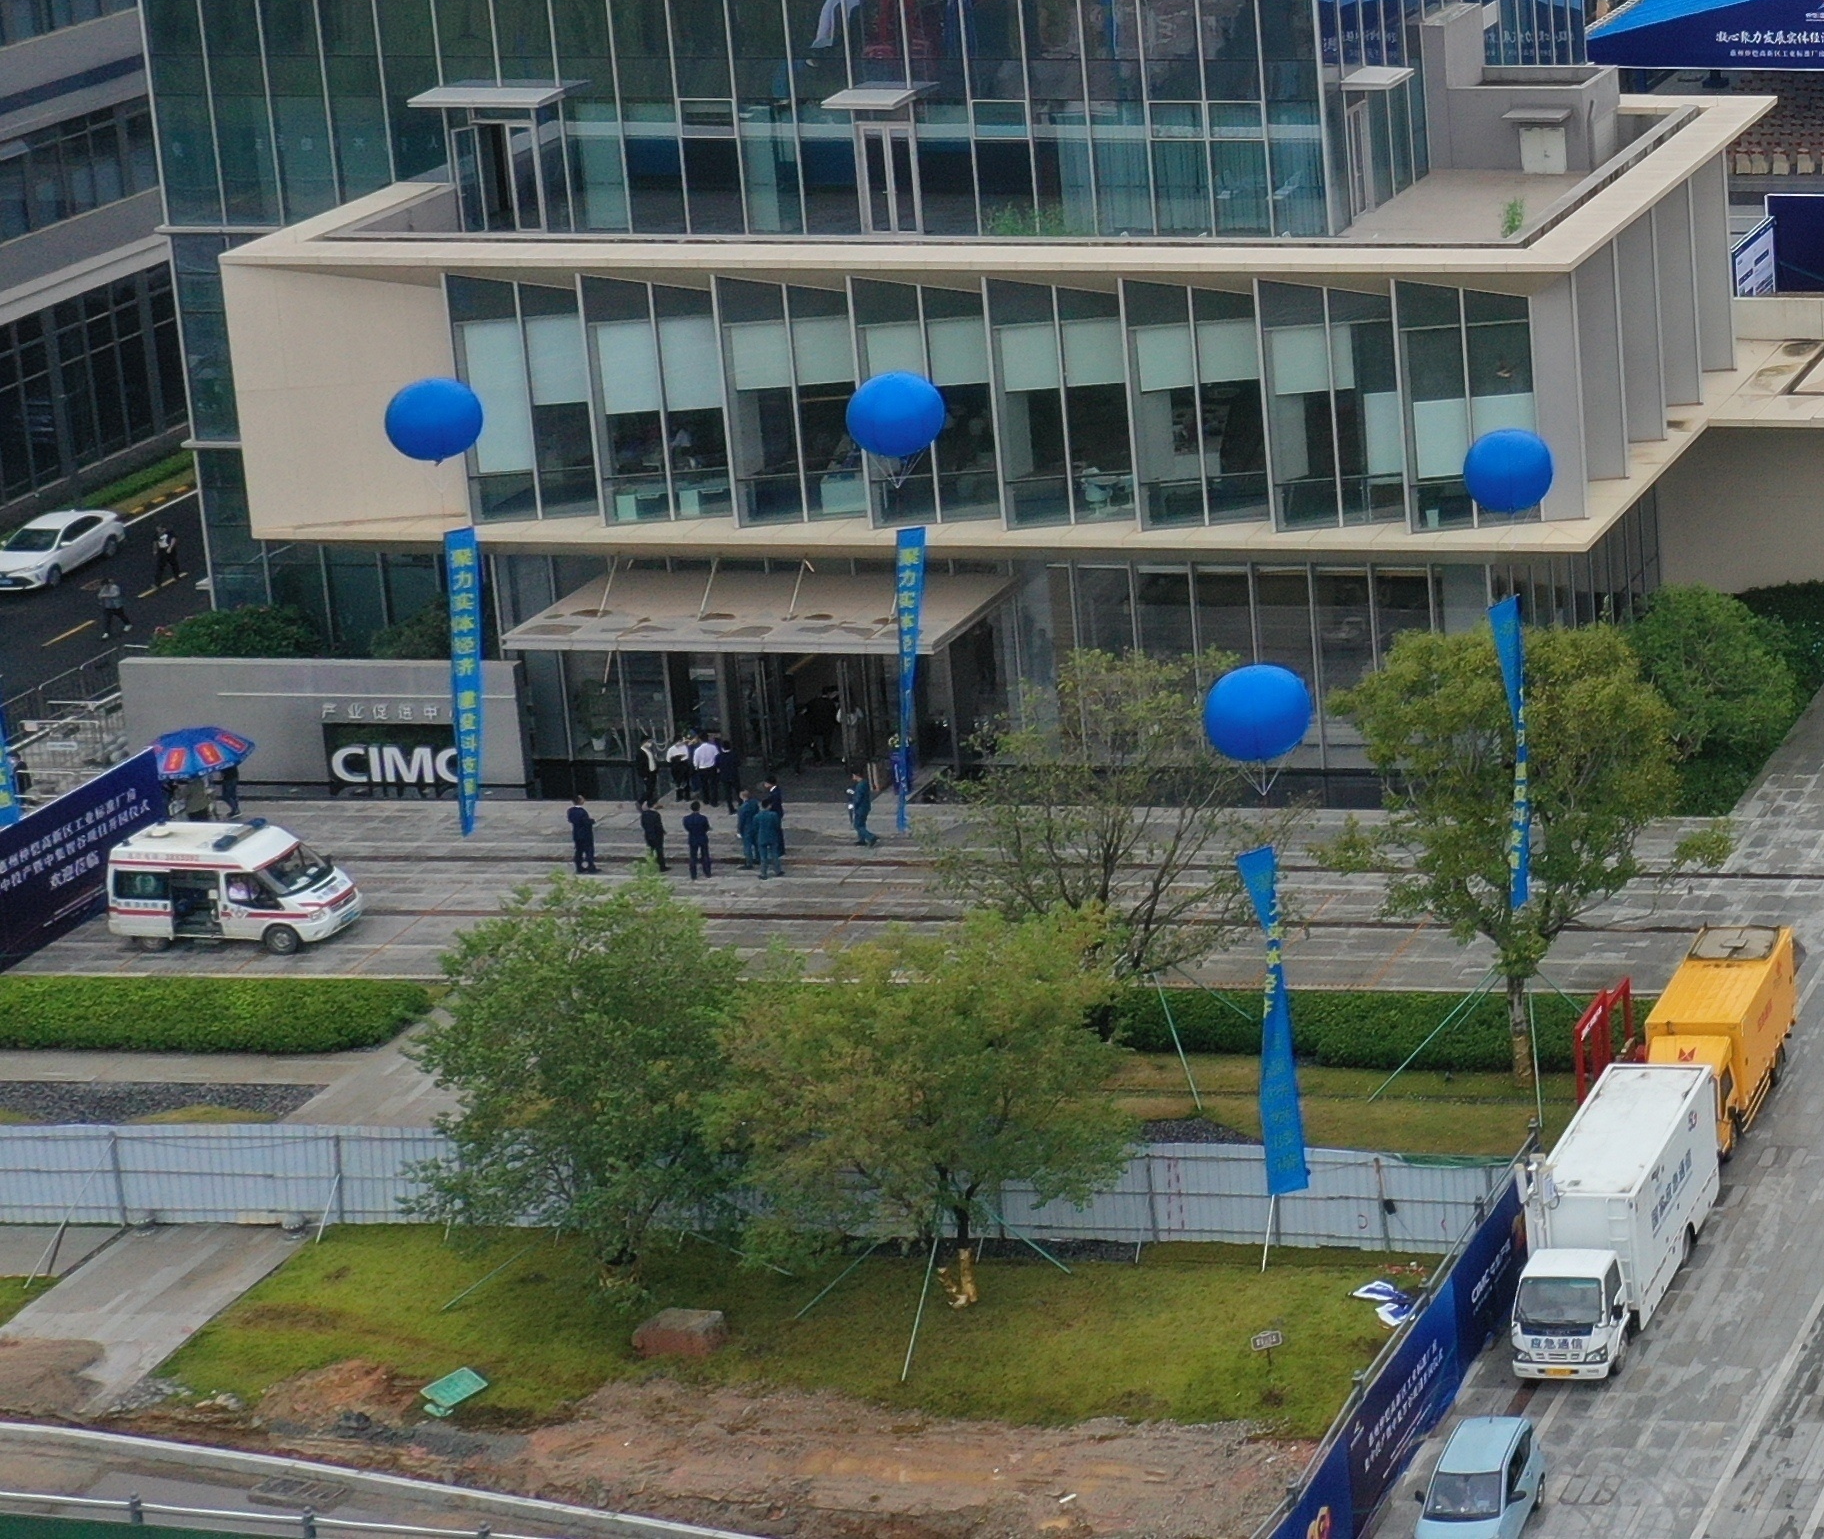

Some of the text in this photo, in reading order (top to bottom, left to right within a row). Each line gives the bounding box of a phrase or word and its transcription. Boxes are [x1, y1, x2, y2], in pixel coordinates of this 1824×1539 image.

[321, 702, 456, 721] 产业促进中
[1530, 1337, 1583, 1350] 应急通信
